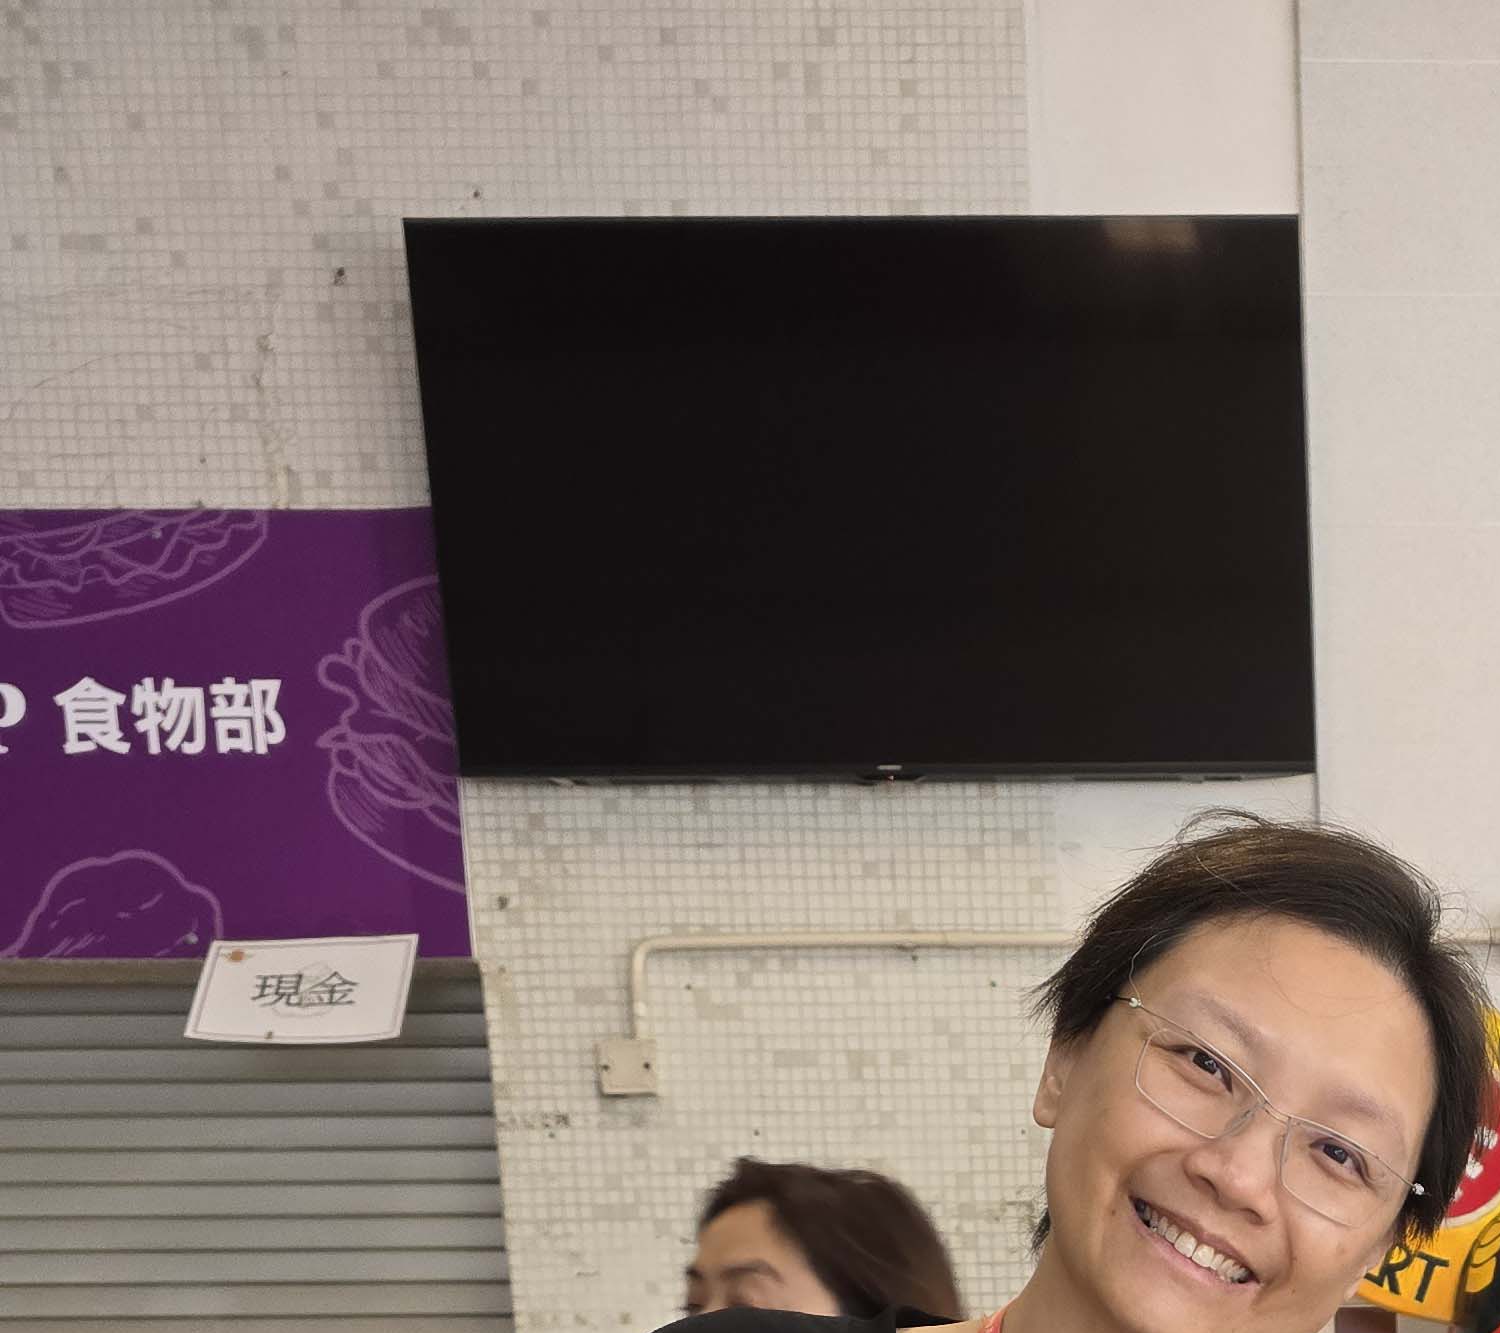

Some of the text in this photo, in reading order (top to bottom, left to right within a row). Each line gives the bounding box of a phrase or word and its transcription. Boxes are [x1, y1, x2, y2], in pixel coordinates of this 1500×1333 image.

[53, 677, 286, 755] 食物部
[251, 972, 360, 1008] 現金
